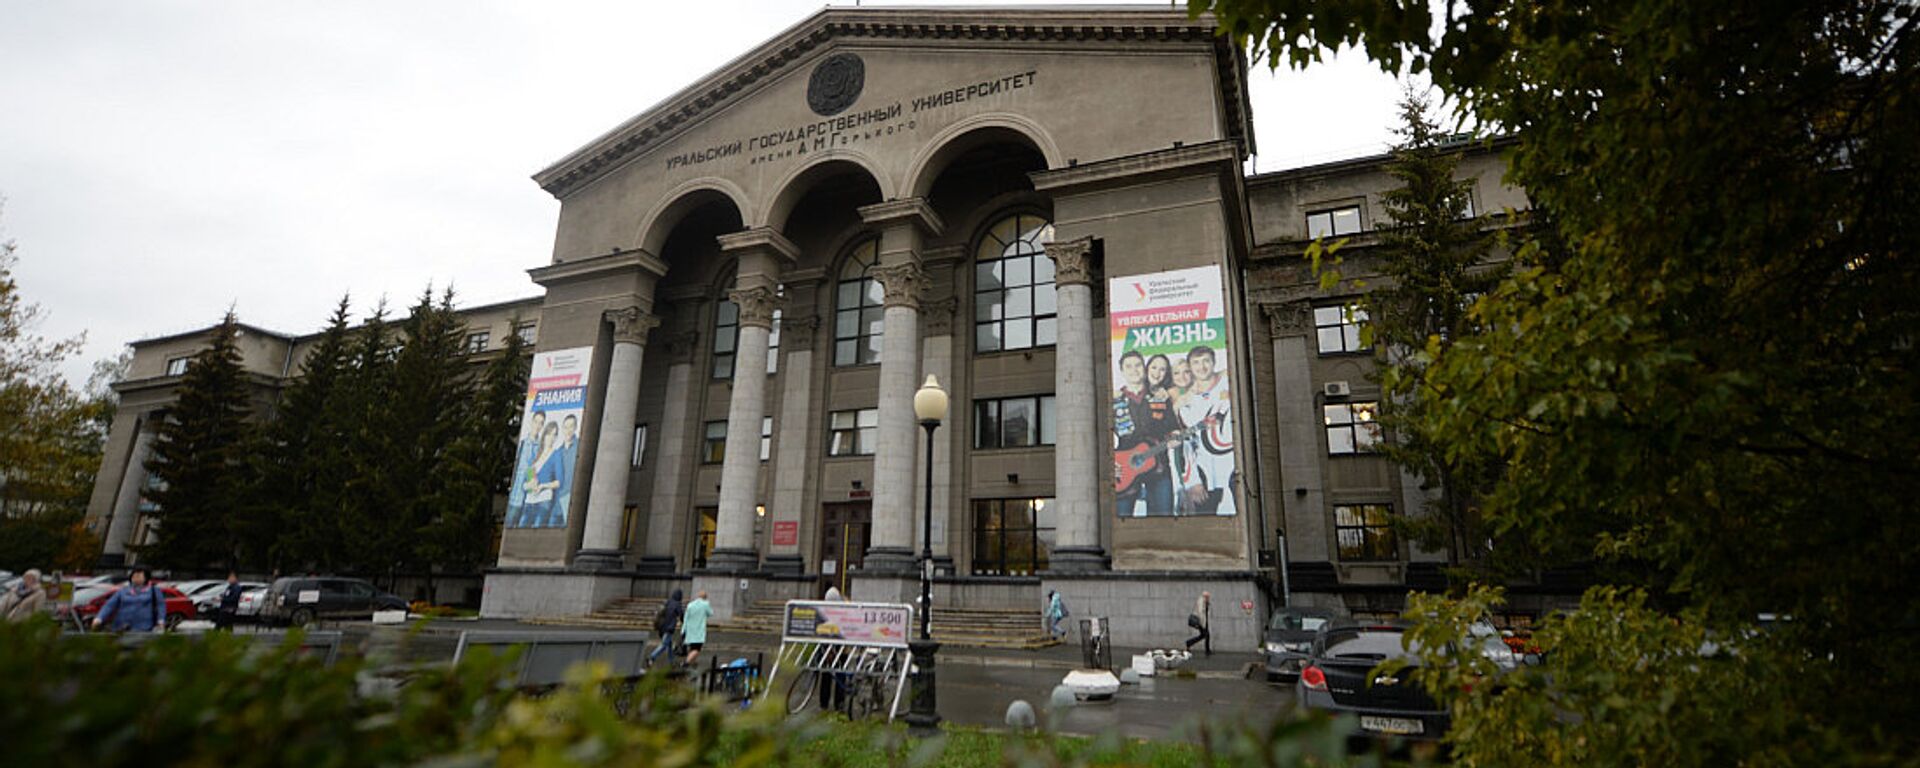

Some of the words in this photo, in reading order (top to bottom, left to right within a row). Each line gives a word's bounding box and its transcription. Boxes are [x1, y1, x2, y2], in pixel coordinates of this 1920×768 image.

[665, 140, 743, 171] УРАЛЬСКИЙ
[749, 101, 902, 152] ГОСУДАРСТВЕННЫЙ
[911, 70, 1037, 113] УНИВЕРСИТЕТ
[1117, 308, 1200, 326] УВЛЕКАТЕЛЬНАЯ
[1132, 321, 1217, 349] ЖИЗНЬ
[535, 388, 583, 406] ЗНАНИЯ
